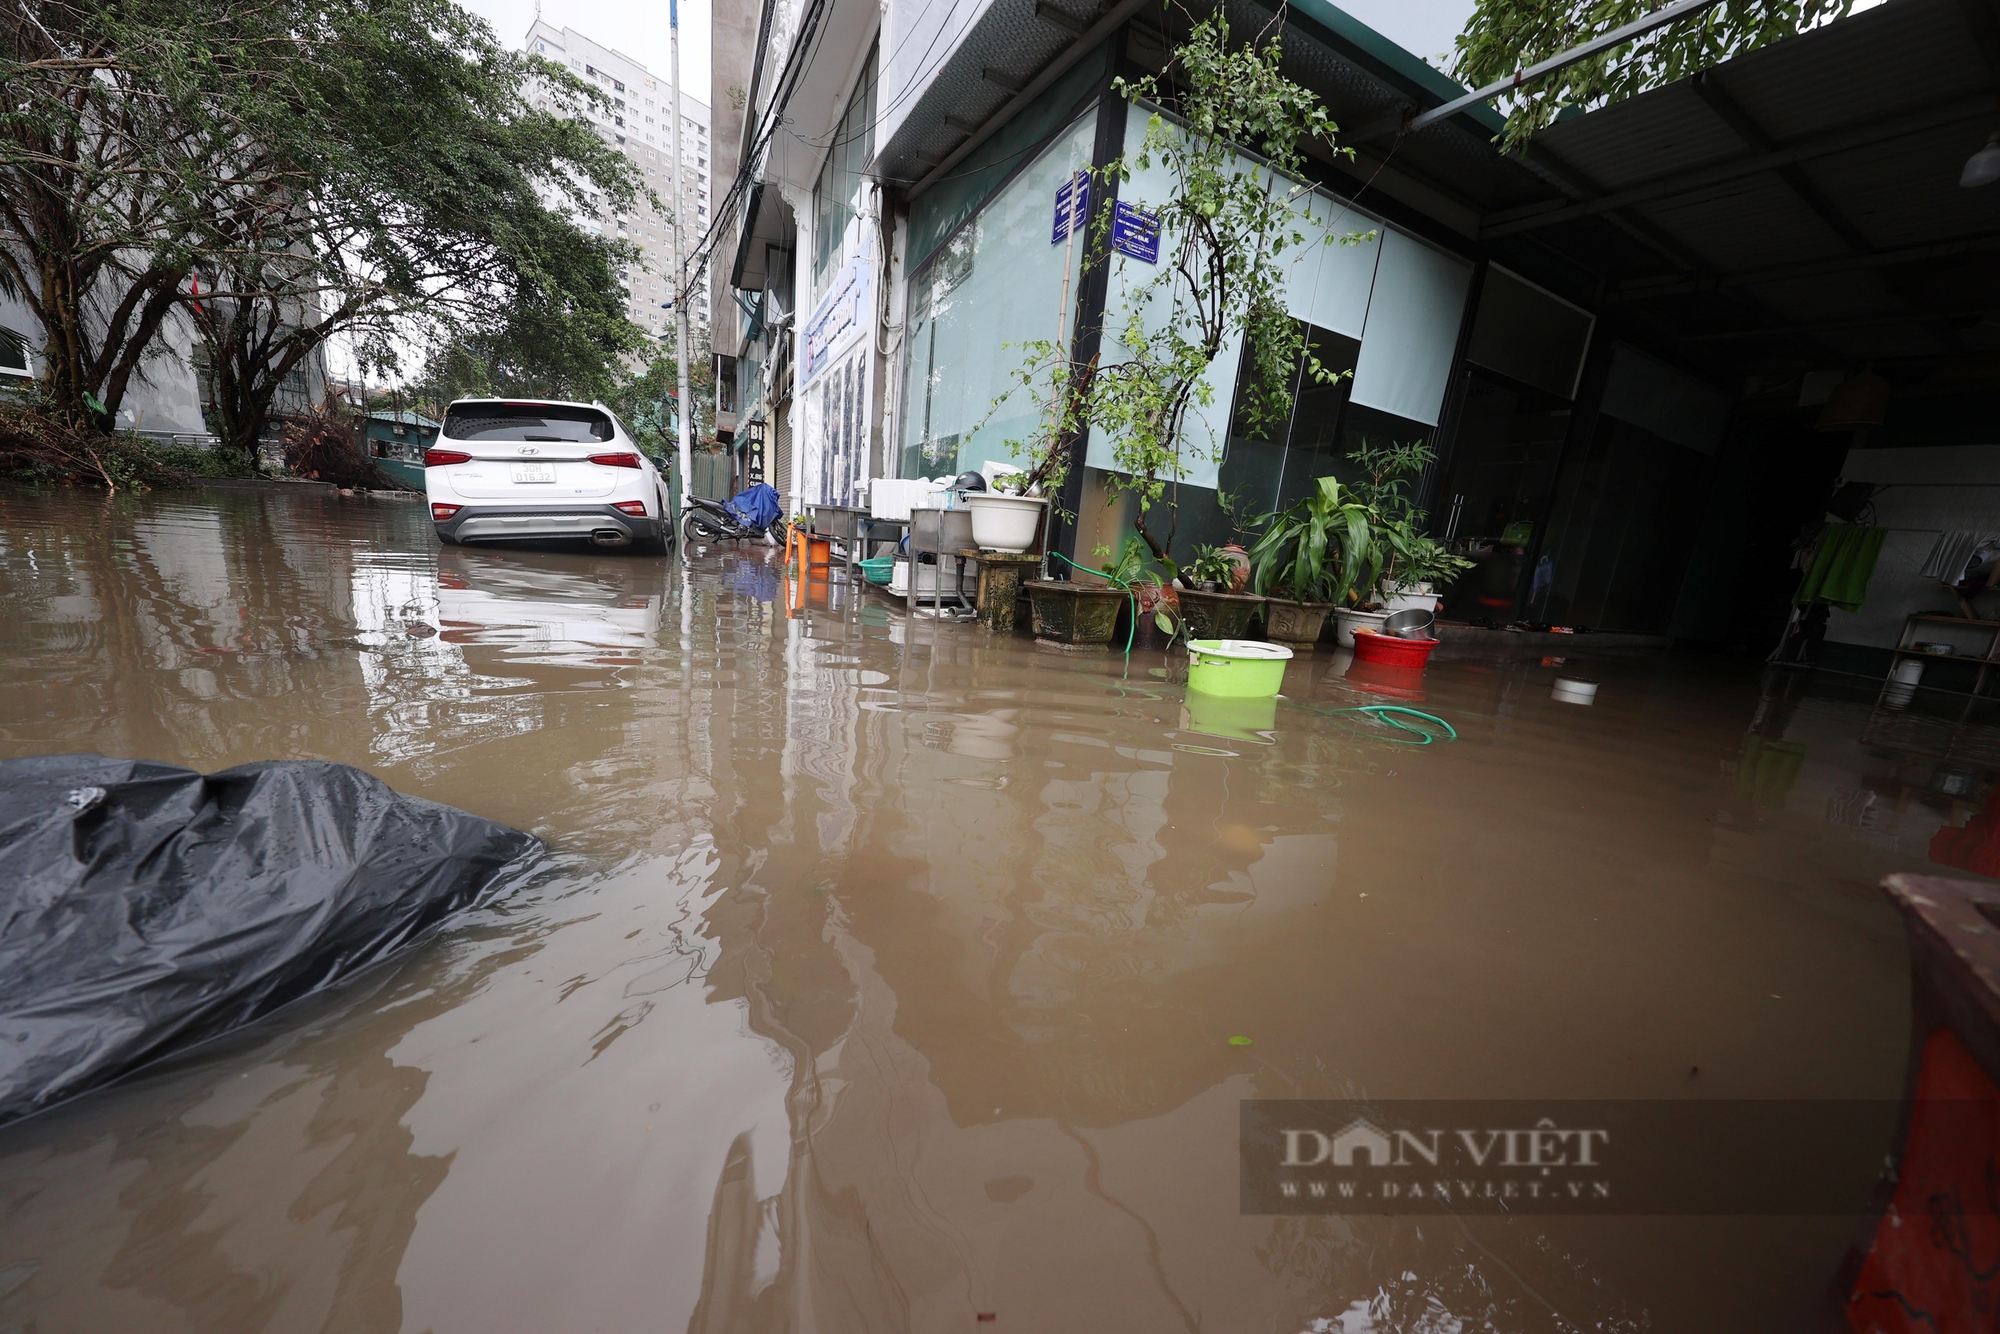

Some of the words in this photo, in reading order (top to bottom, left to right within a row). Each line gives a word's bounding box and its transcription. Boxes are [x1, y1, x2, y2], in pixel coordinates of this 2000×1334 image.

[750, 425, 762, 440] BI
[751, 454, 761, 469] A
[522, 464, 542, 473] 30H
[516, 473, 551, 482] 016.32
